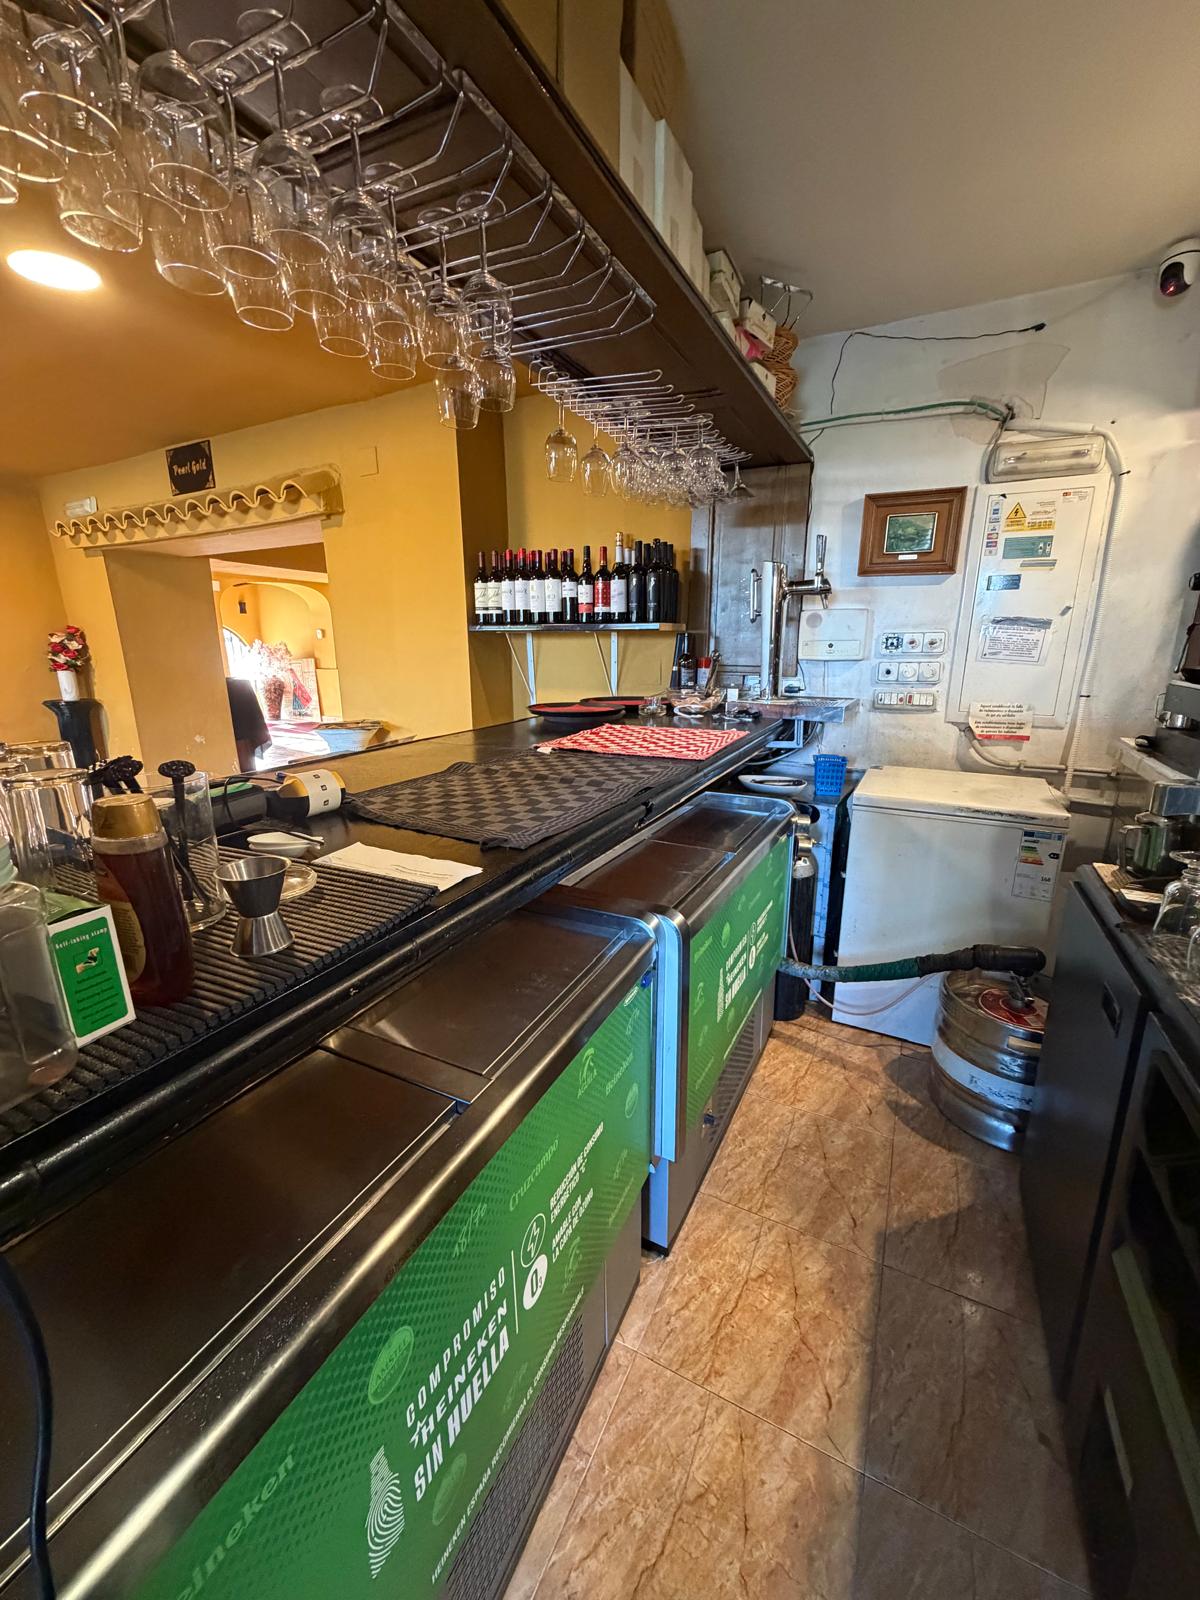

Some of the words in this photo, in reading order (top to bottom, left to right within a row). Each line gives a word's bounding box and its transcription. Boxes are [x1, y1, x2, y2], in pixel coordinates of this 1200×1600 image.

[172, 461, 191, 476] Pearl
[191, 458, 207, 475] Gold
[510, 1139, 559, 1211] Cruzcampo
[406, 1266, 505, 1428] COMPROMISO
[414, 1433, 443, 1502] SIN
[447, 1325, 509, 1448] HUELLA
[421, 1298, 508, 1447] HEINEKEN
[177, 1454, 294, 1600] eineken
[431, 1518, 466, 1584] HEINEKEN
[492, 1399, 527, 1468] RECOMIENDA
